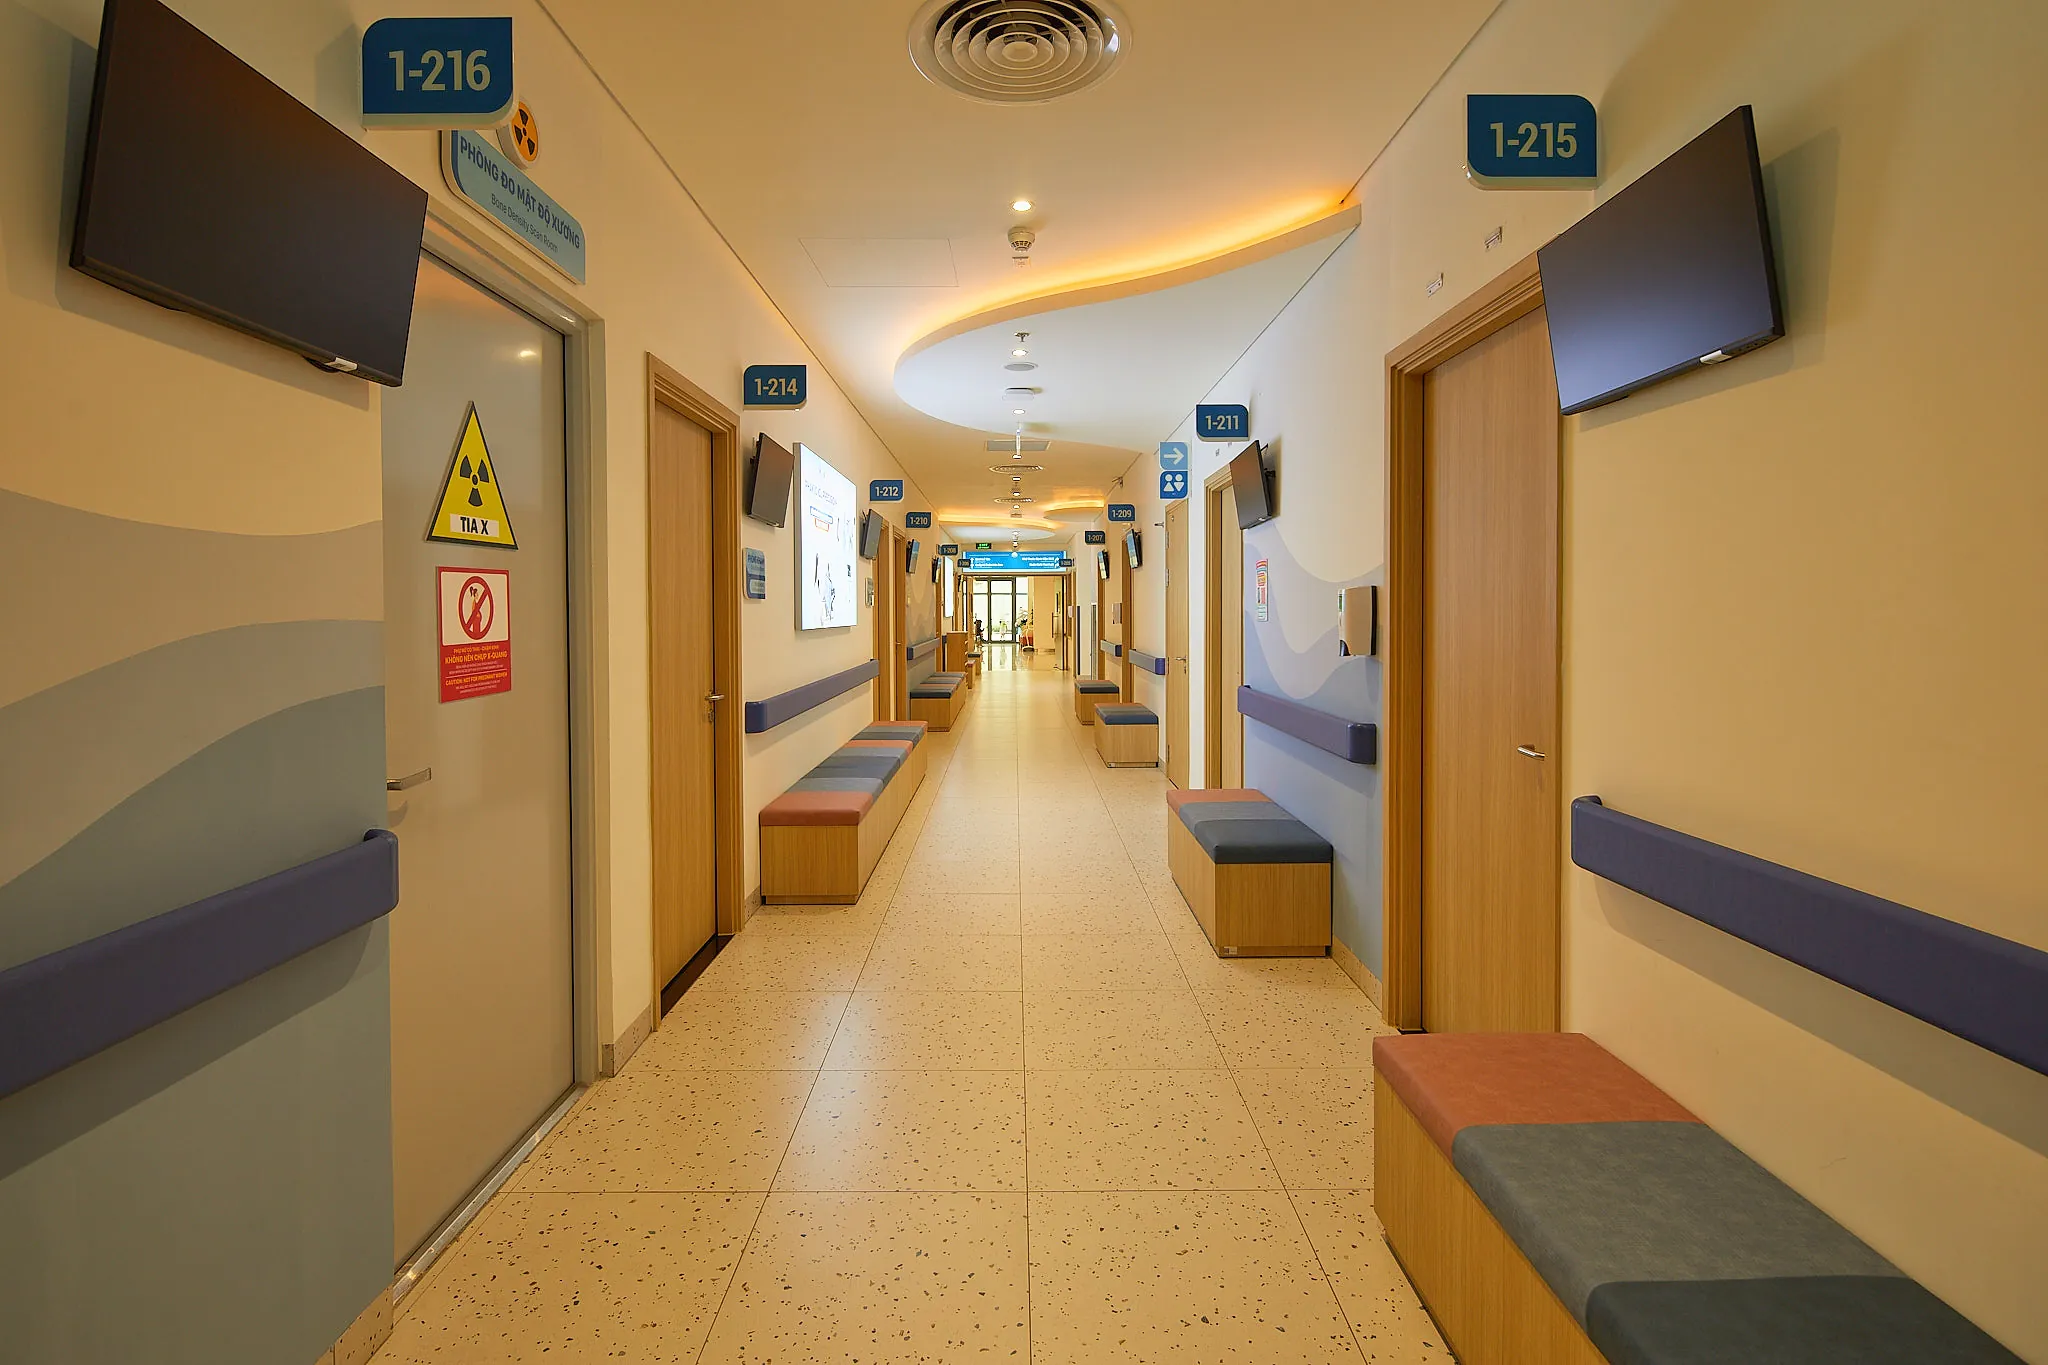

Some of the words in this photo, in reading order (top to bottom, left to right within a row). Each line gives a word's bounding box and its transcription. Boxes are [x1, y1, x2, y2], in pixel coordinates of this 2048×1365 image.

[388, 49, 491, 91] 1-216
[1489, 122, 1577, 159] 1-215
[460, 135, 499, 182] PHÒNG
[501, 170, 515, 195] ĐO
[517, 183, 536, 213] MẬT
[538, 201, 550, 228] ĐỘ
[551, 214, 580, 249] XƯƠNG
[491, 193, 507, 214] Bone
[507, 206, 530, 233] Density
[529, 224, 544, 242] Scan
[544, 234, 559, 253] Room
[754, 377, 798, 397] 1-214
[1205, 415, 1239, 430] 1-211
[875, 486, 899, 497] 1-212
[909, 516, 928, 525] 1-210
[1112, 509, 1132, 518] 1-209
[460, 516, 478, 534] TIA
[481, 519, 489, 535] X
[1087, 534, 1103, 542] 1-207
